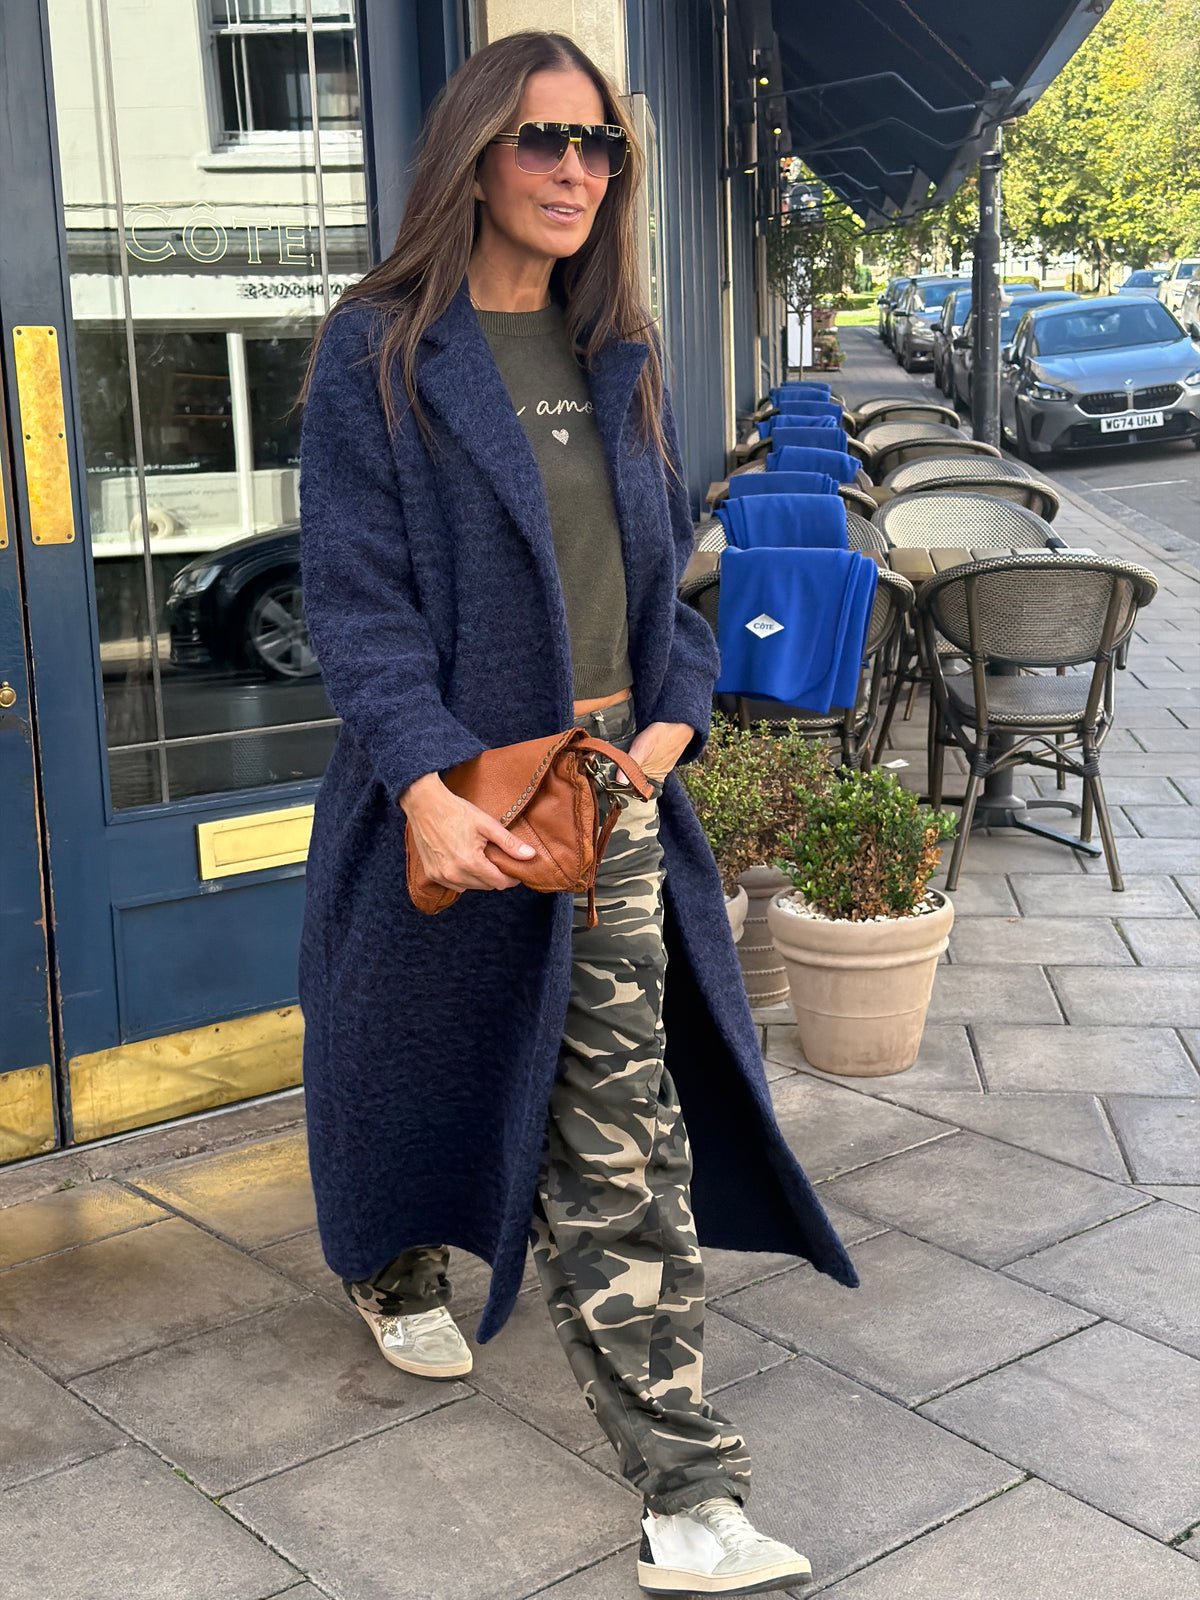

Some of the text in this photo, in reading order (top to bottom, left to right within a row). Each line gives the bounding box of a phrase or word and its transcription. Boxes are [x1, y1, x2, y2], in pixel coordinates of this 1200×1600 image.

[124, 200, 315, 267] CÔTE
[1105, 414, 1158, 430] WG74 UHA
